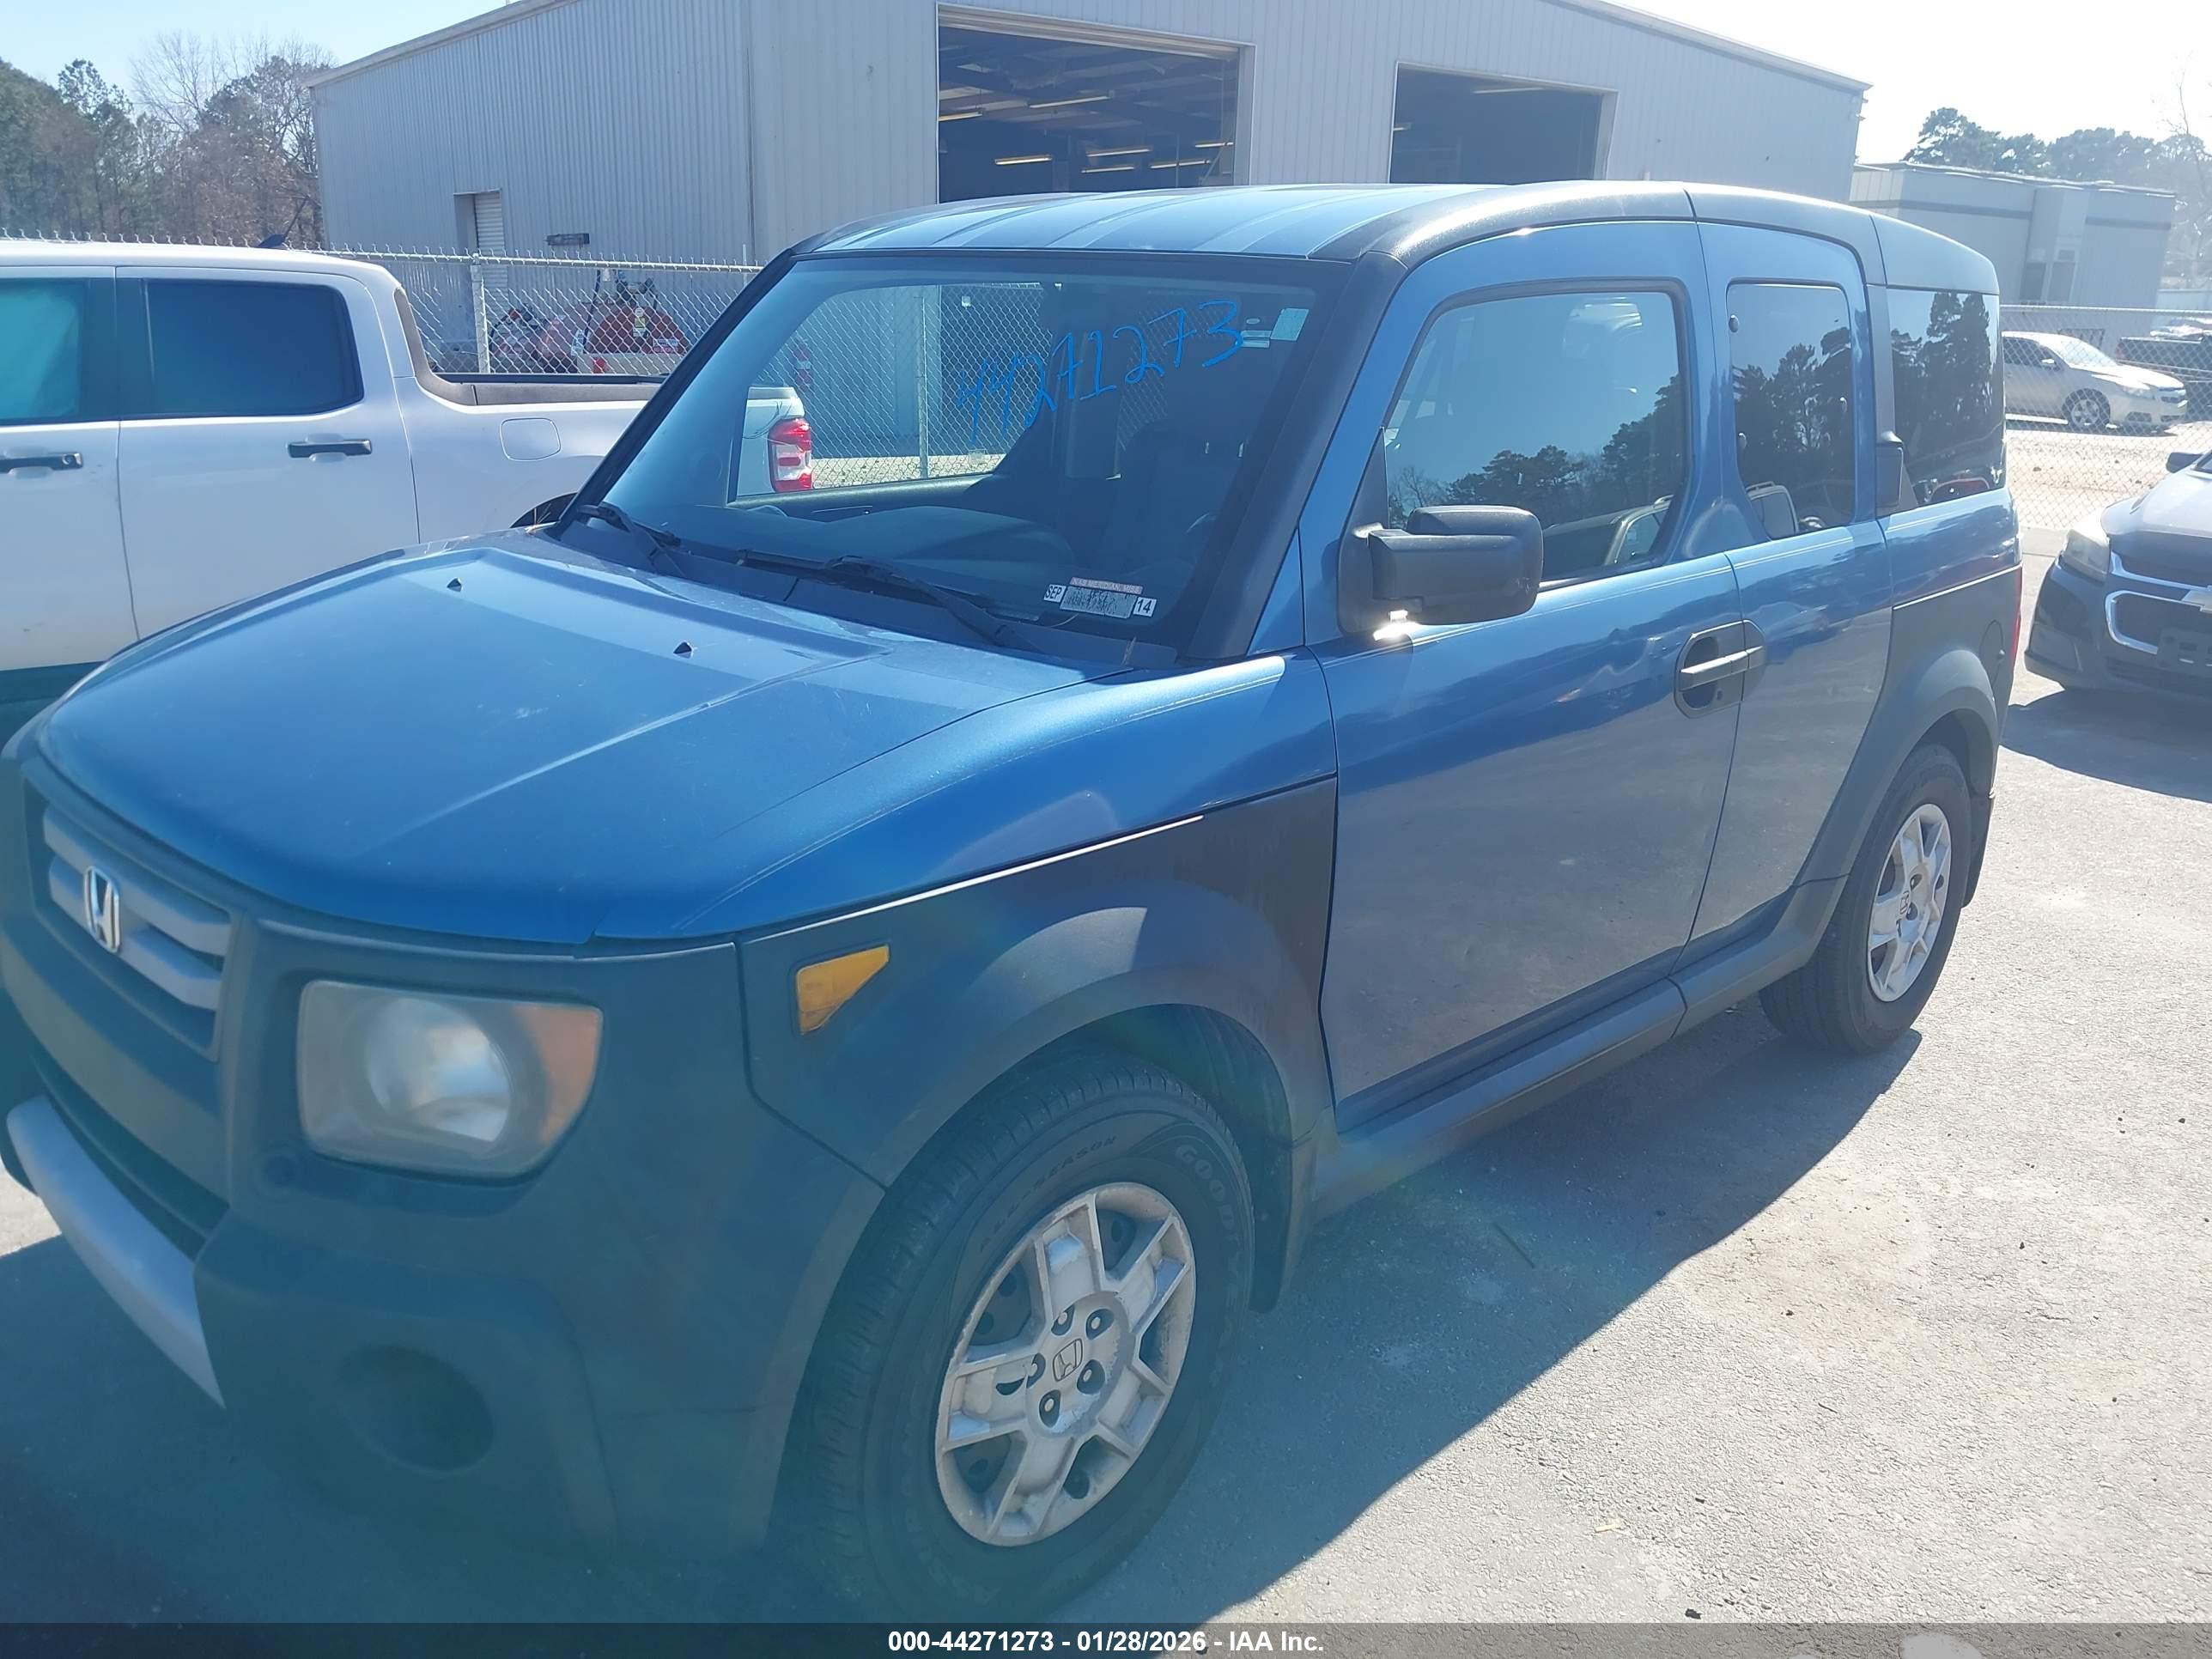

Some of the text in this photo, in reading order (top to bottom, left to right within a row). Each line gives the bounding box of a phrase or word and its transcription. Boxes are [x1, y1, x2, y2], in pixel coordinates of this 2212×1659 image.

[957, 299, 1244, 444] 44271273
[1045, 586, 1062, 599] SEP
[1137, 600, 1152, 614] 14
